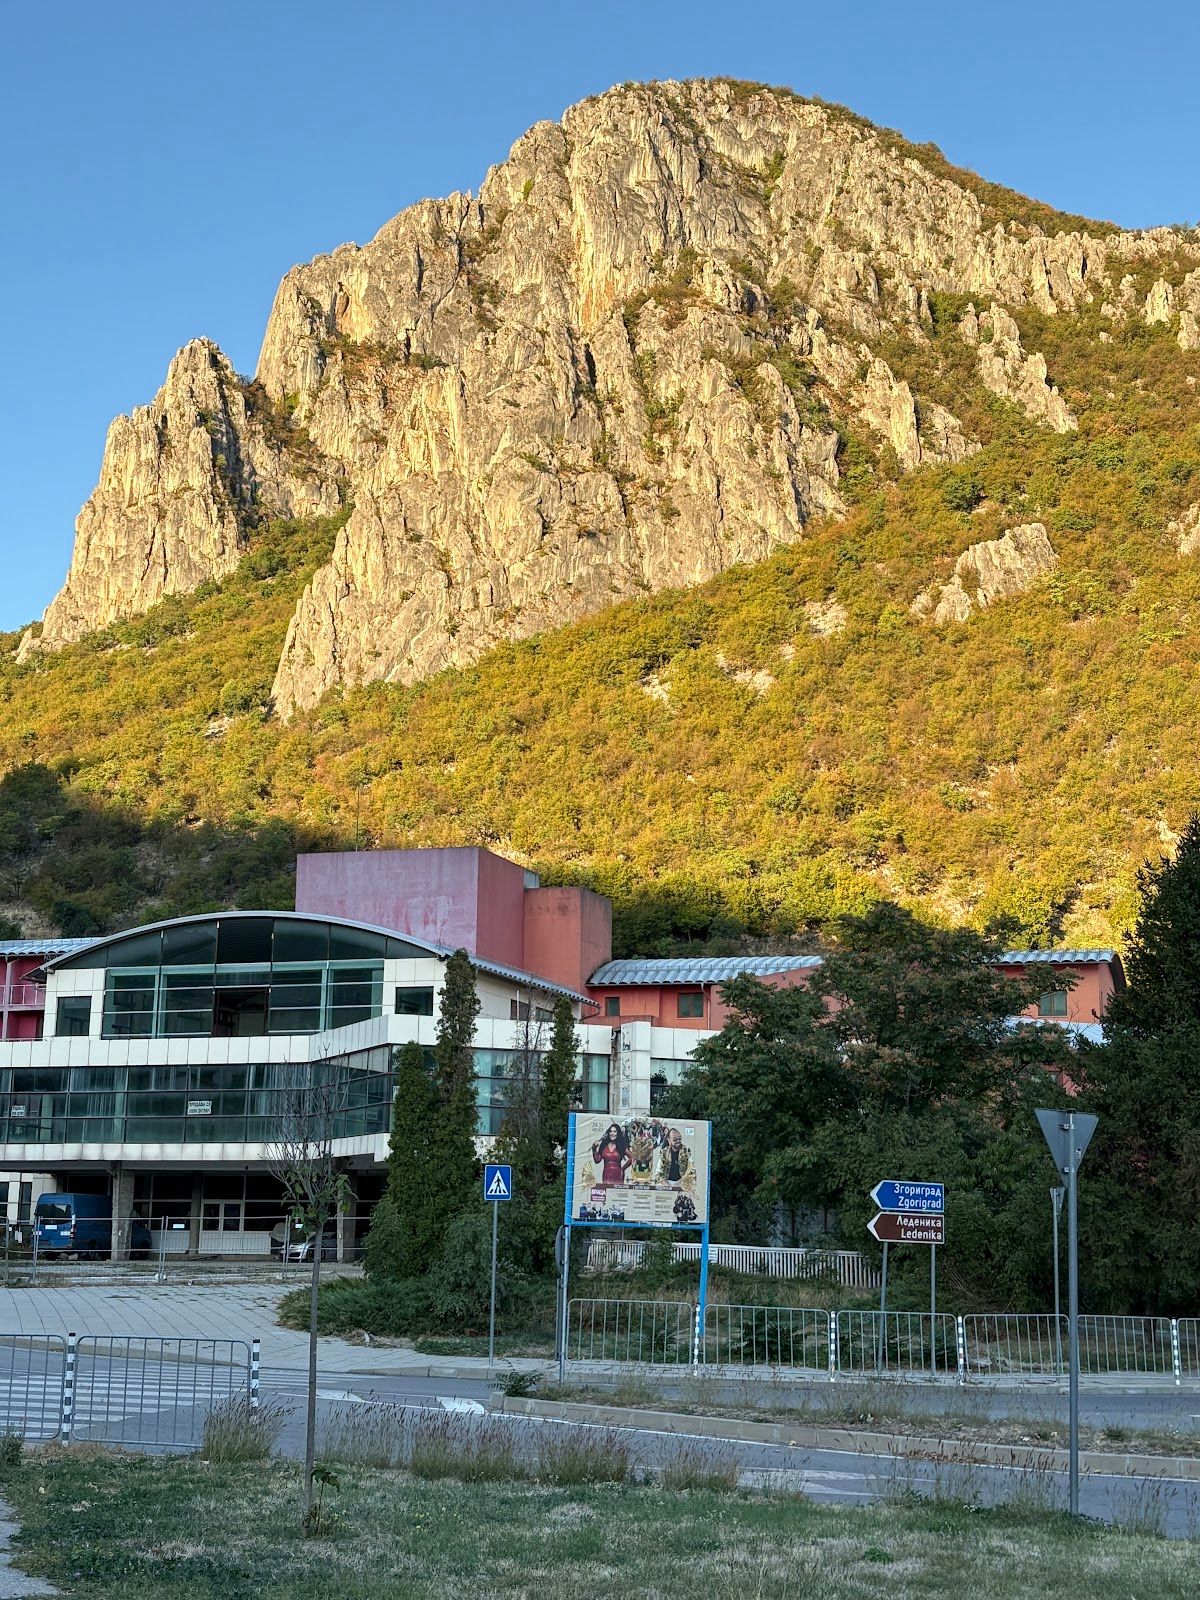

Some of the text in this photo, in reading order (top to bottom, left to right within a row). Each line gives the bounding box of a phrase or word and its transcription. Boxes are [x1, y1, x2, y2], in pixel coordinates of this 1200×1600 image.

[894, 1183, 942, 1197] Згориград
[898, 1196, 942, 1209] Zgorigrad
[896, 1215, 942, 1228] Леденика
[901, 1228, 942, 1240] Ledenika
